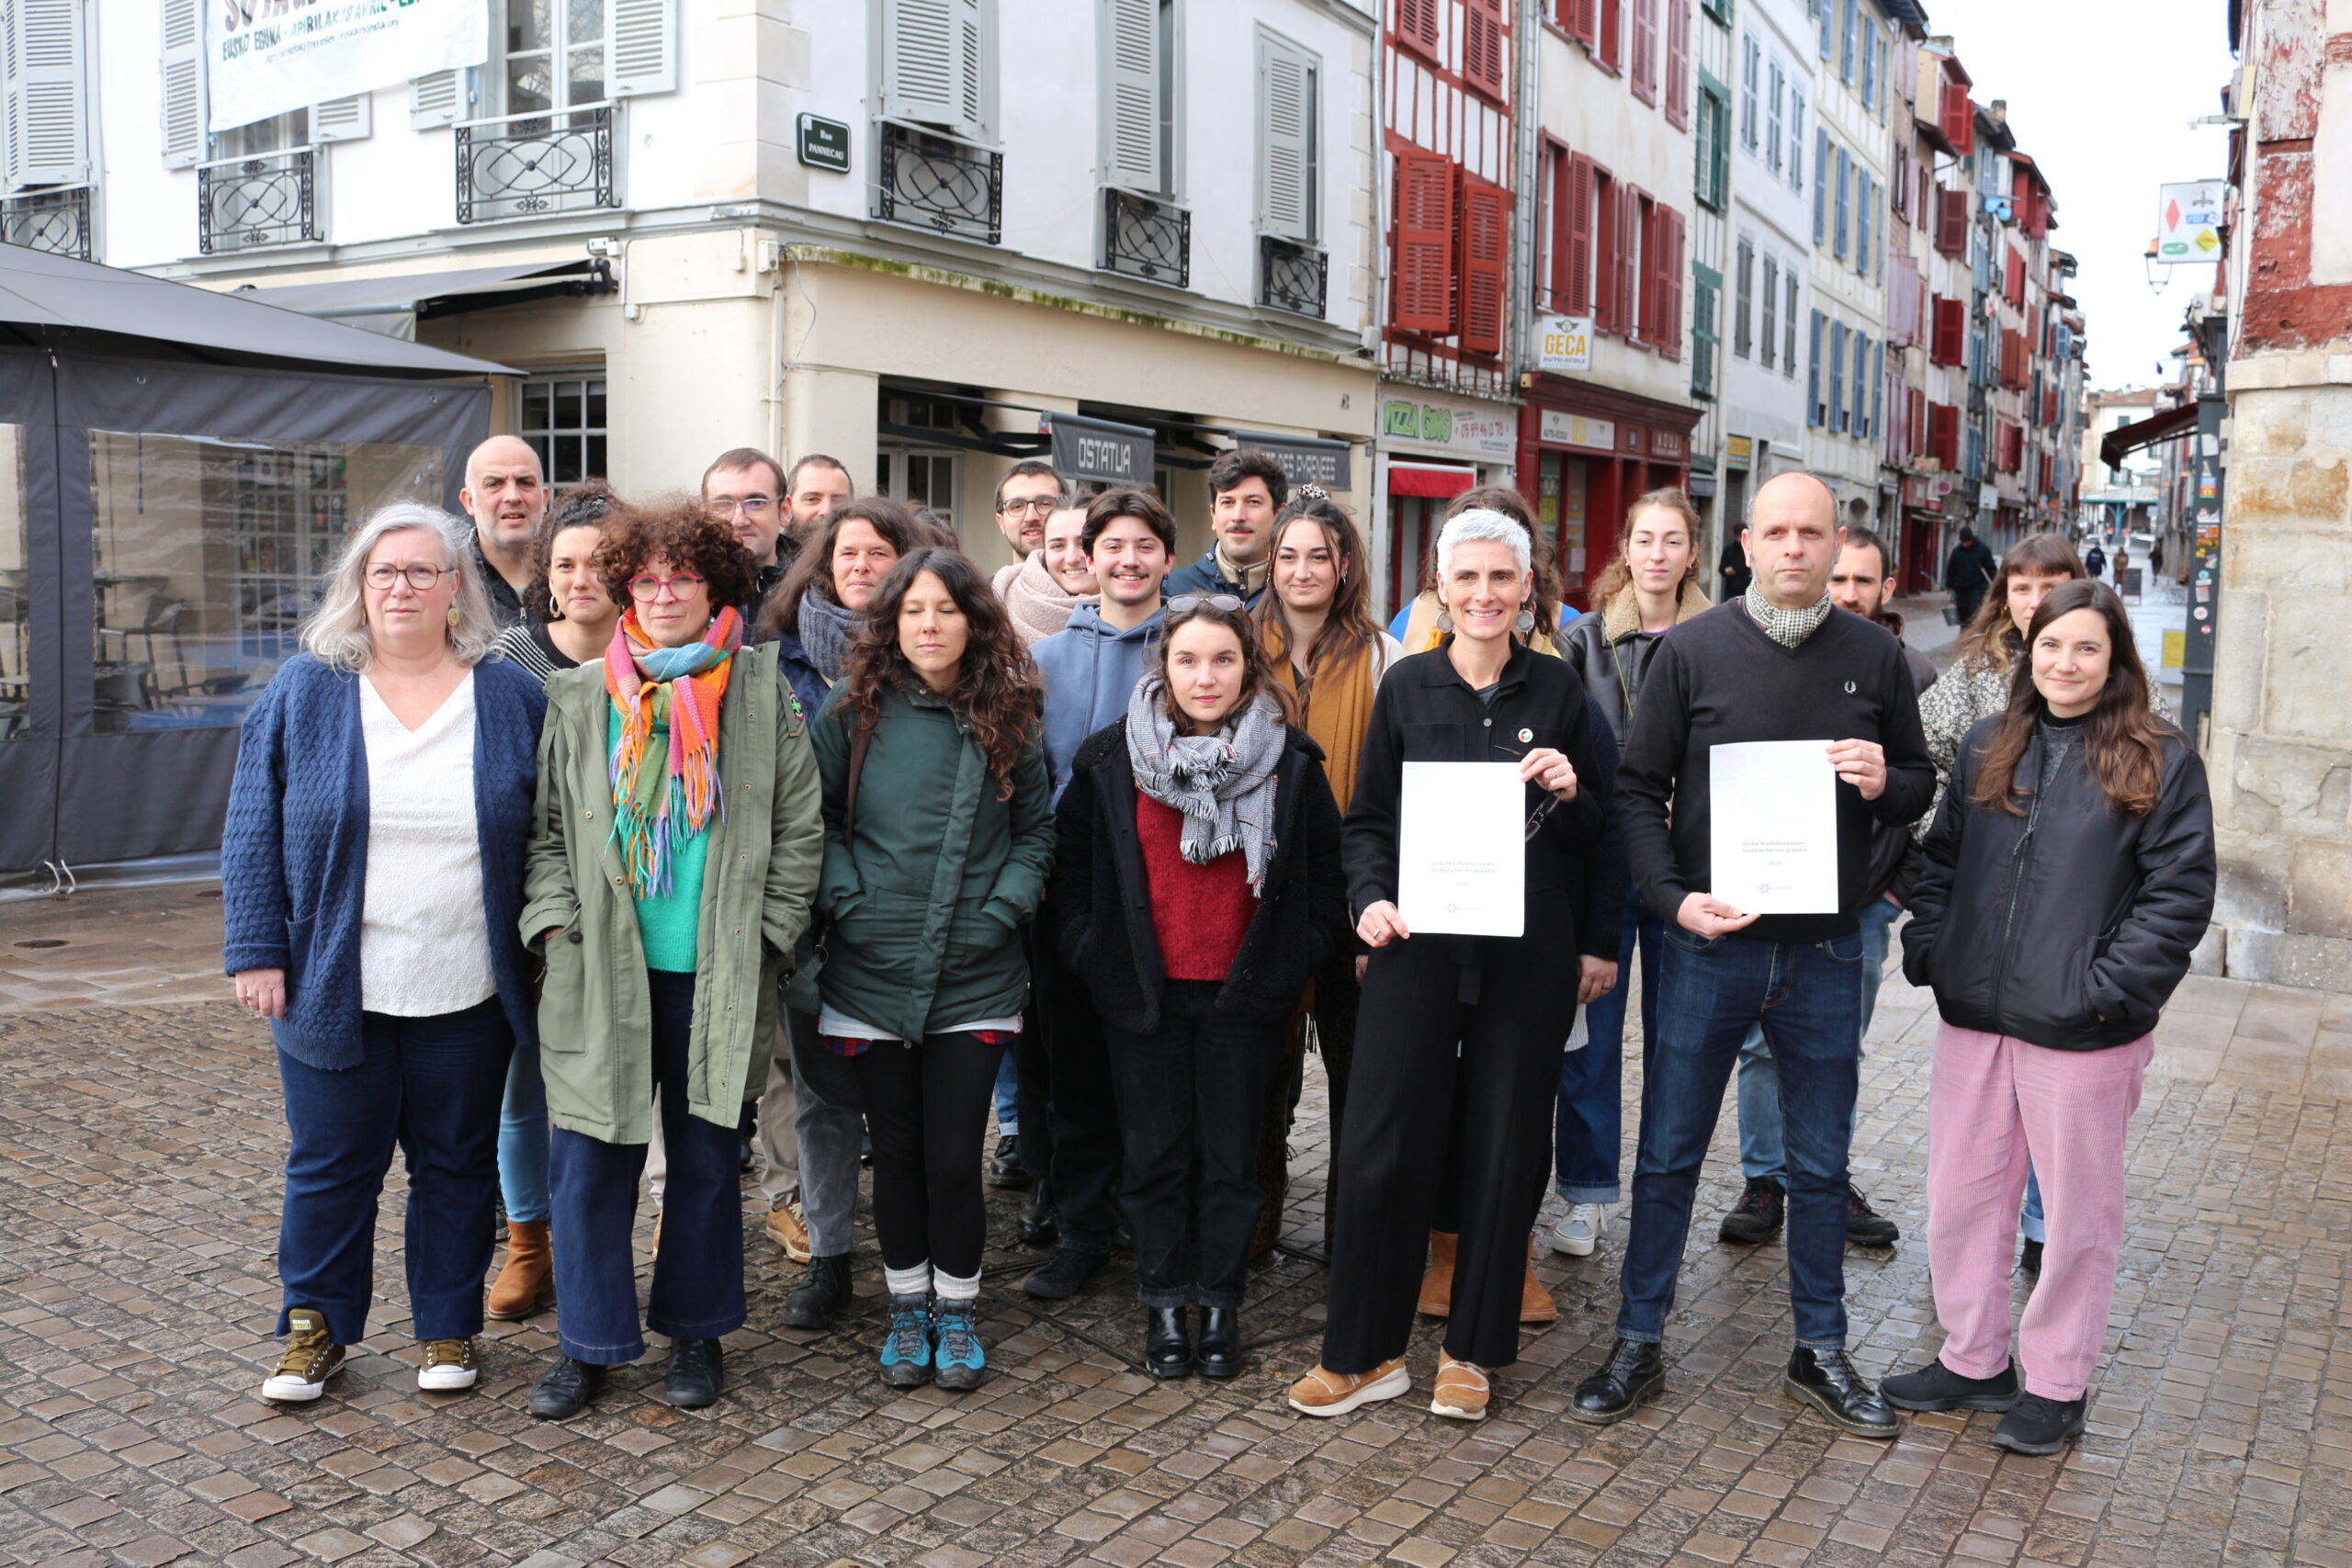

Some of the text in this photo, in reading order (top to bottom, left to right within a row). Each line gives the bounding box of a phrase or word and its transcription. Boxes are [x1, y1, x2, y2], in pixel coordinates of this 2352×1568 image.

[820, 129, 833, 141] Rue
[1544, 333, 1586, 355] GECA
[1078, 436, 1131, 475] OSTATUA
